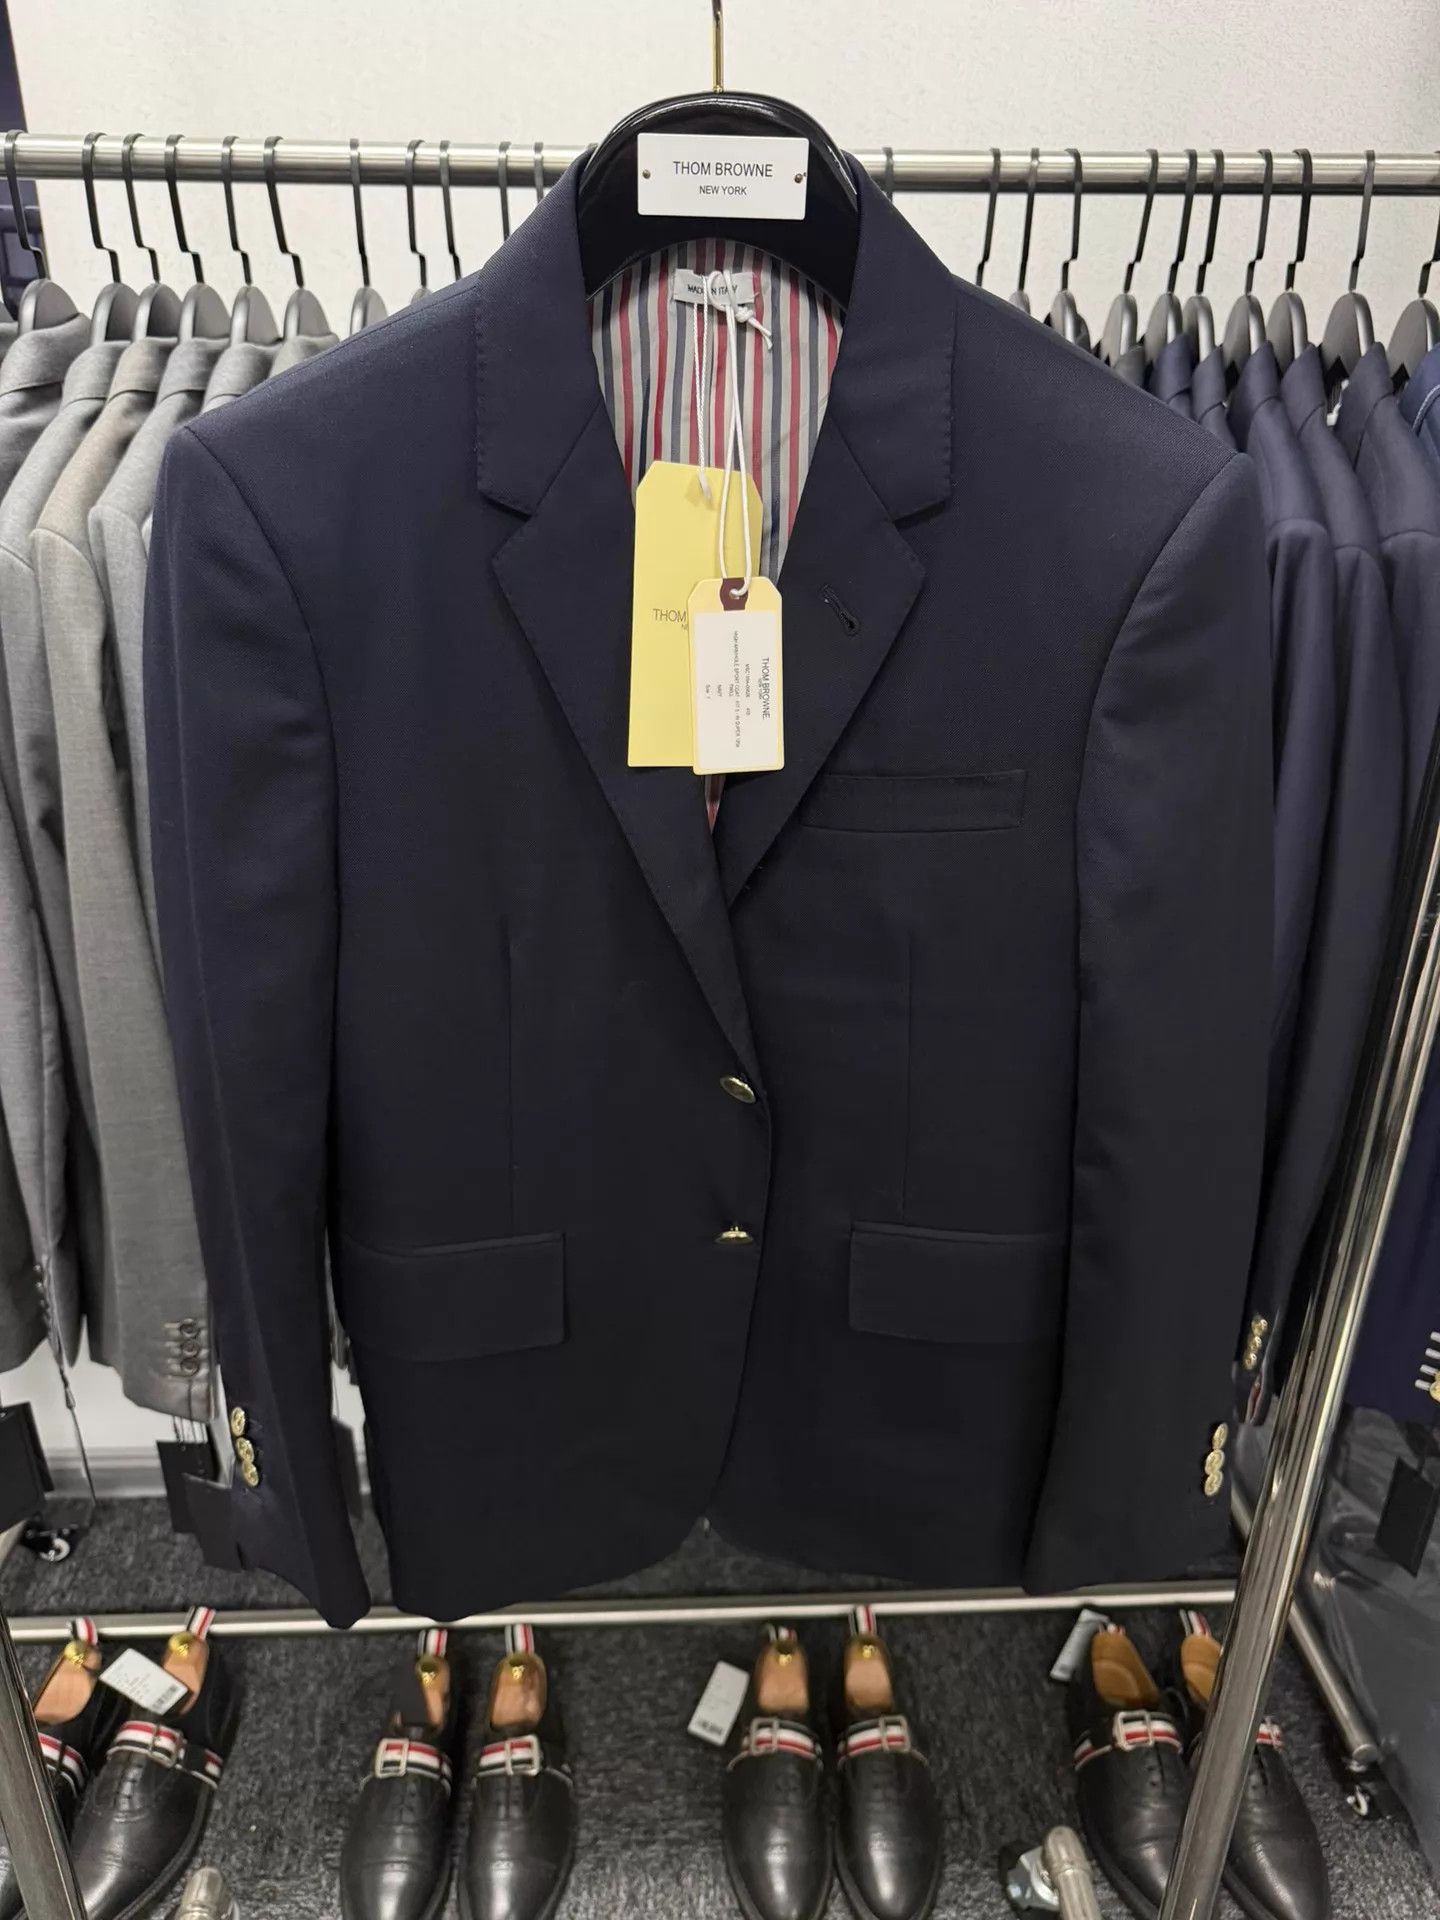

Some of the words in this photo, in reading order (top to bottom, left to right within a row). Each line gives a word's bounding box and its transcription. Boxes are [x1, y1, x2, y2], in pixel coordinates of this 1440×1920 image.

[673, 161, 711, 176] THOM
[715, 162, 773, 177] BROWNE
[699, 185, 719, 195] NEW
[721, 185, 747, 195] YORK
[718, 285, 738, 296] ITAY
[652, 608, 687, 622] THOM
[762, 657, 770, 682] THOM
